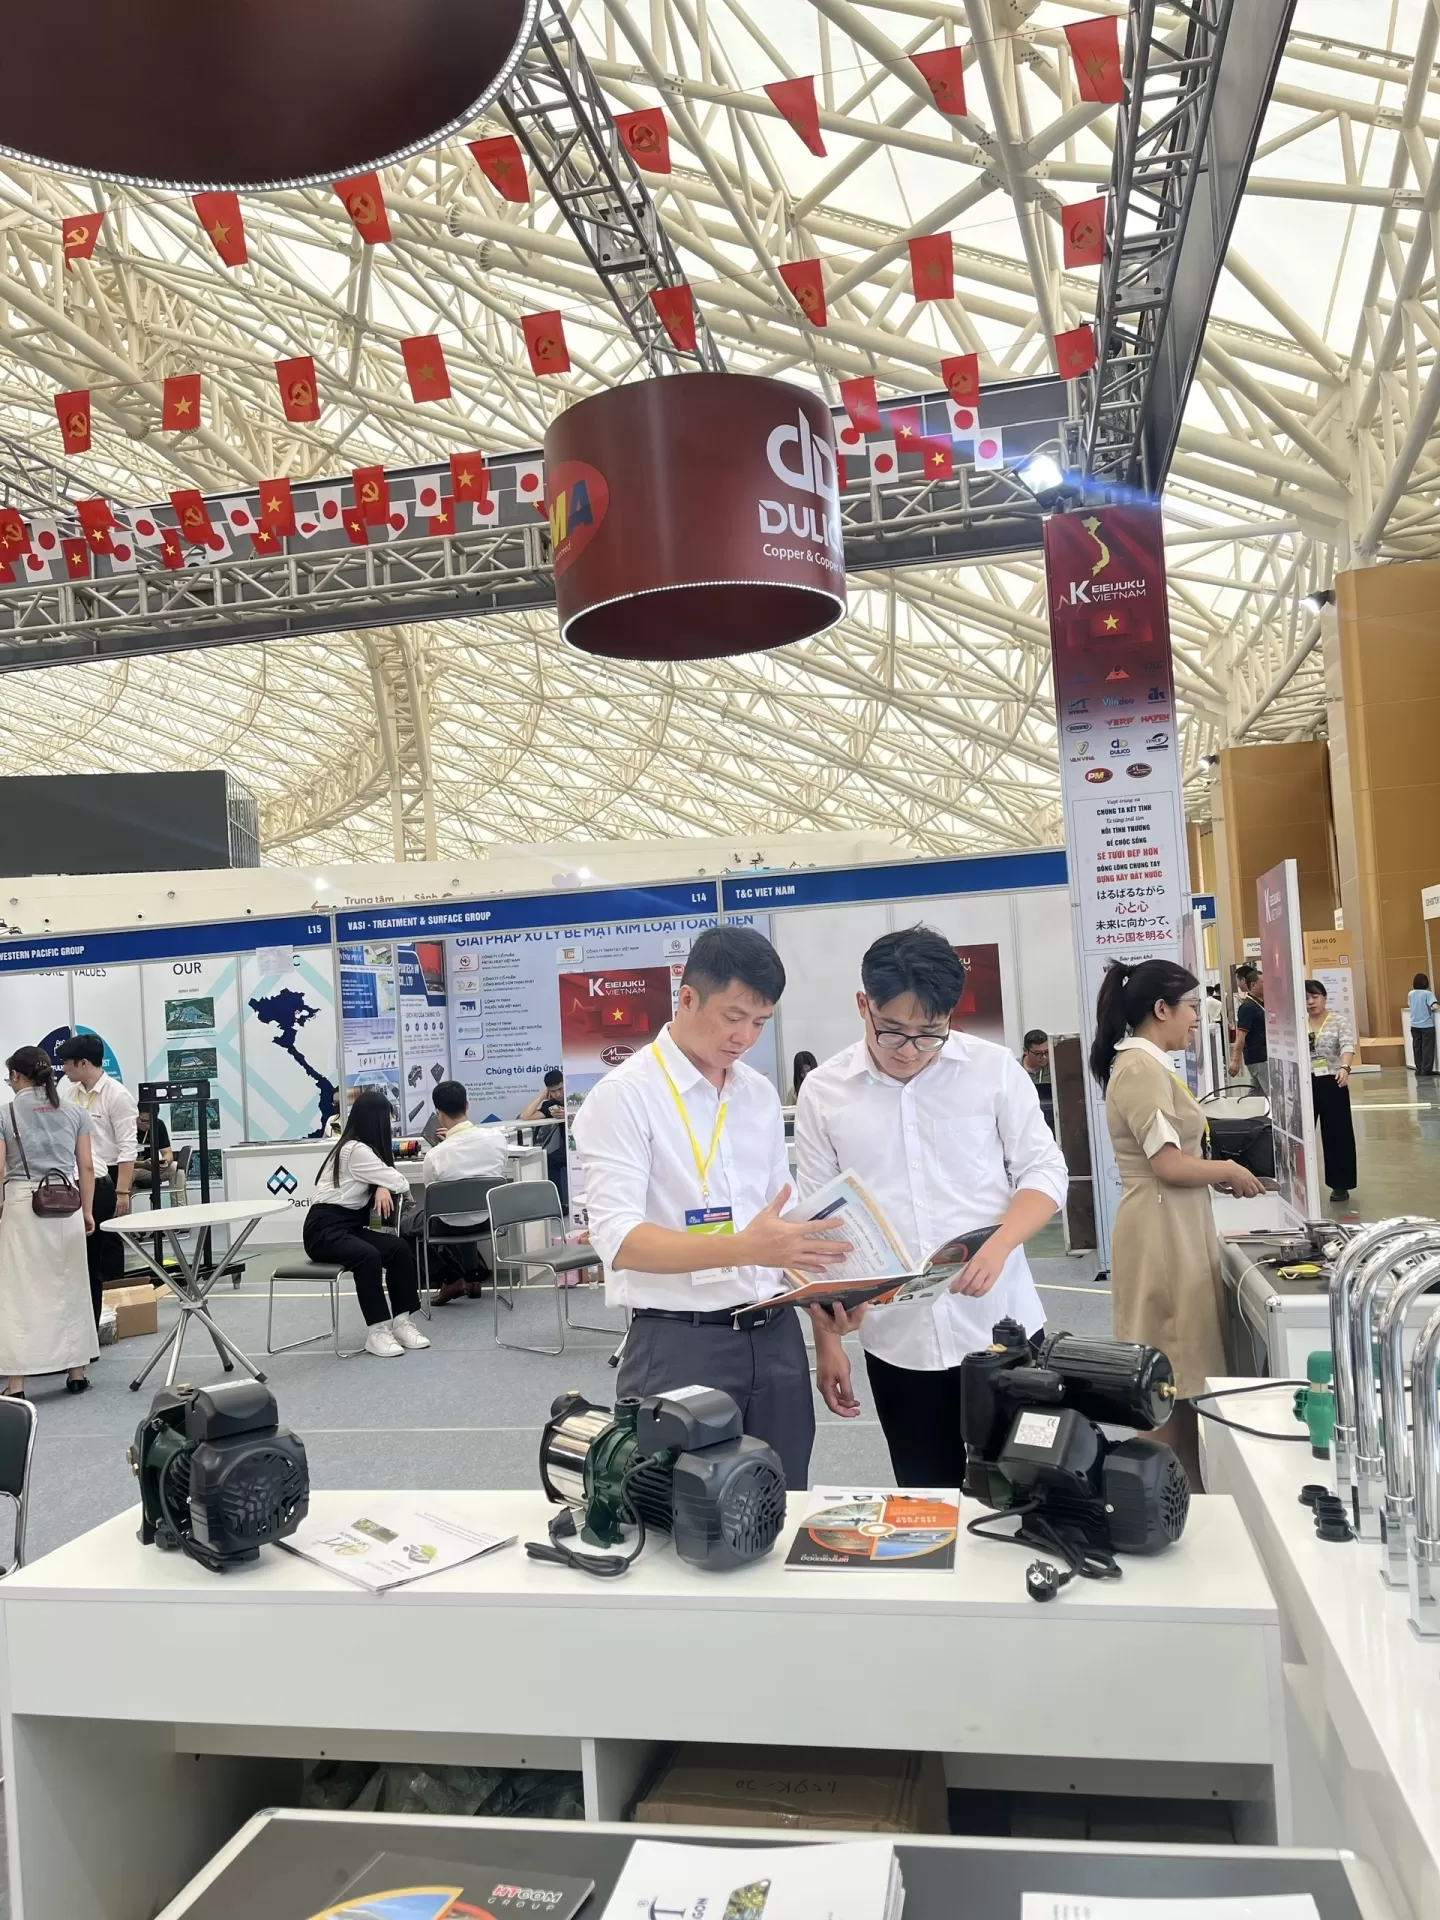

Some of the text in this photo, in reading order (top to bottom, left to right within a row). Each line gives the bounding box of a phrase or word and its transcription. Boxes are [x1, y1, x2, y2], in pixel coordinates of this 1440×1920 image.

[763, 544, 804, 560] Copper
[807, 550, 813, 562] &
[816, 553, 838, 572] Copper
[1093, 589, 1146, 602] VIETNAM
[692, 893, 706, 902] L14
[736, 885, 795, 898] T&C VIET NAM
[1097, 886, 1165, 900] はるばるながら
[1115, 901, 1149, 914] 心と心
[348, 921, 365, 930] VASI
[373, 917, 417, 929] TREATMENT
[420, 916, 425, 926] &
[428, 914, 462, 925] SURFACE
[465, 912, 491, 922] GROUP
[1096, 916, 1169, 930] 未来に向かって、
[308, 924, 322, 934] L15
[1096, 929, 1172, 944] われら国を明るく
[31, 949, 59, 958] PACIFIC
[60, 946, 84, 956] GROUP
[173, 962, 201, 975] OUR
[606, 988, 646, 996] VIETNAM
[486, 1067, 512, 1076] Chúng
[514, 1066, 525, 1074] tôi
[526, 1065, 541, 1074] đáp
[492, 1884, 562, 1903] HTCOM
[488, 1898, 554, 1911] GROUP
